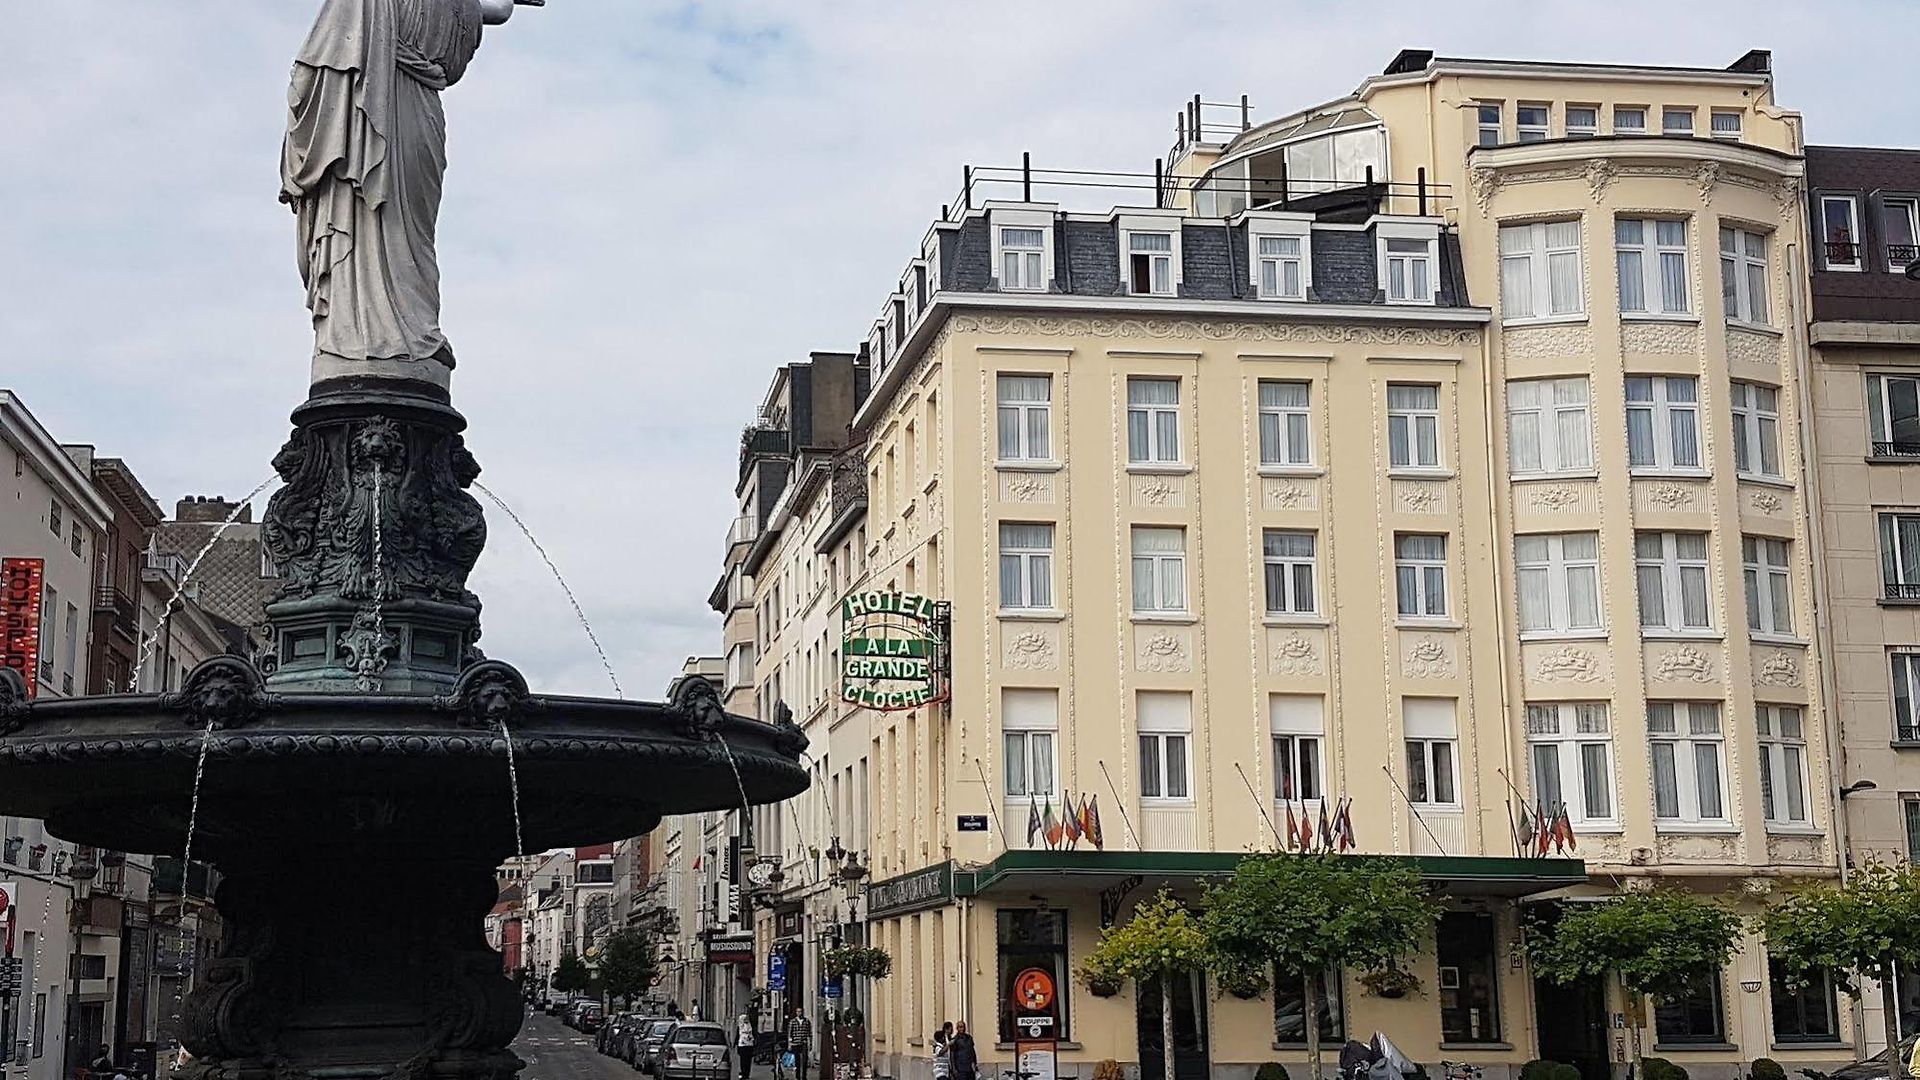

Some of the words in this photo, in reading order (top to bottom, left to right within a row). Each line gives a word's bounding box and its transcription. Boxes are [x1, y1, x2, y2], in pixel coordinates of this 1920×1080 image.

[845, 590, 930, 620] HOTEL
[885, 638, 911, 655] LA
[846, 660, 929, 678] GRANDE
[844, 685, 929, 708] CLOCHE
[729, 884, 739, 916] TAMA
